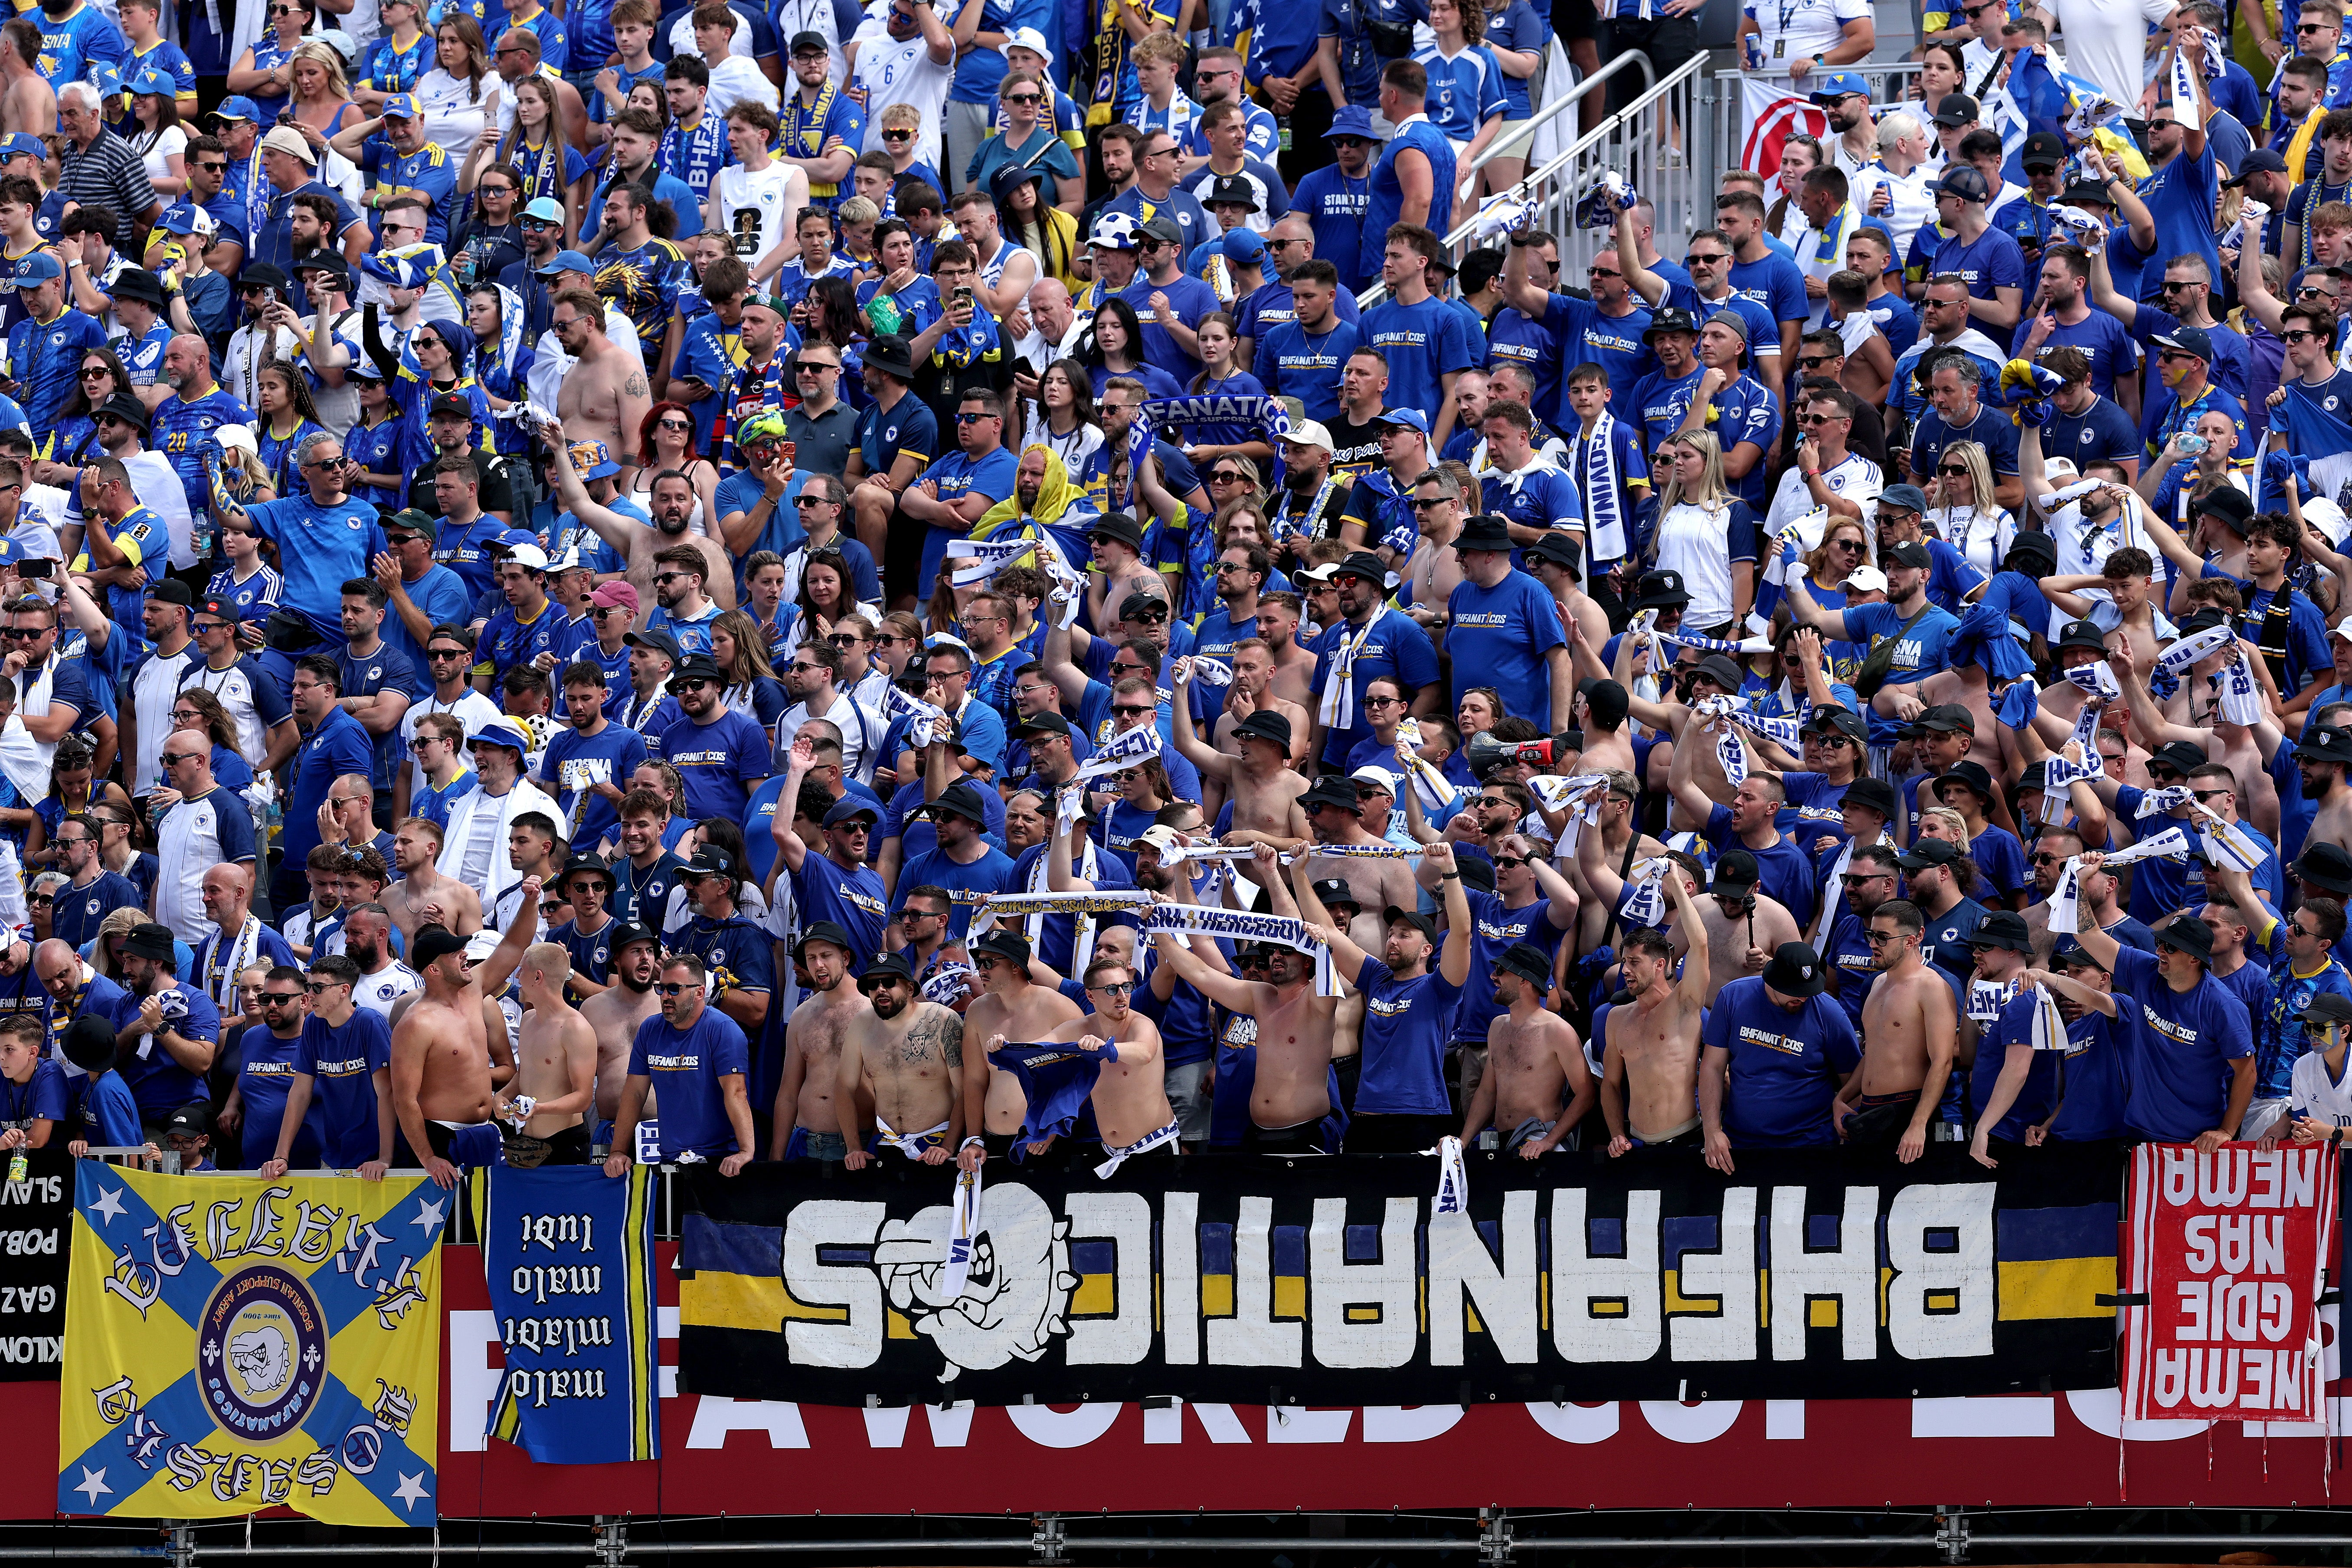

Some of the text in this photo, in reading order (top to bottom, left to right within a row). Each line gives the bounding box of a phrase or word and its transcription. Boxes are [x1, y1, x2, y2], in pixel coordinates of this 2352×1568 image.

[167, 432, 187, 452] 20
[672, 751, 726, 763] BHFANATICOS
[1740, 1026, 1804, 1052] BHFANATICOS
[2163, 1148, 2319, 1208] NEMA
[2185, 1215, 2285, 1274] NAS
[212, 1275, 314, 1333] BOSNIAN SUPPORT ARMY
[513, 1266, 602, 1303] malo
[263, 1313, 281, 1321] since
[511, 1369, 606, 1407] malo
[2154, 1348, 2302, 1409] NEMA
[208, 1377, 310, 1432] BHFANATICOS
[91, 1374, 418, 1505] BOSANSKA
